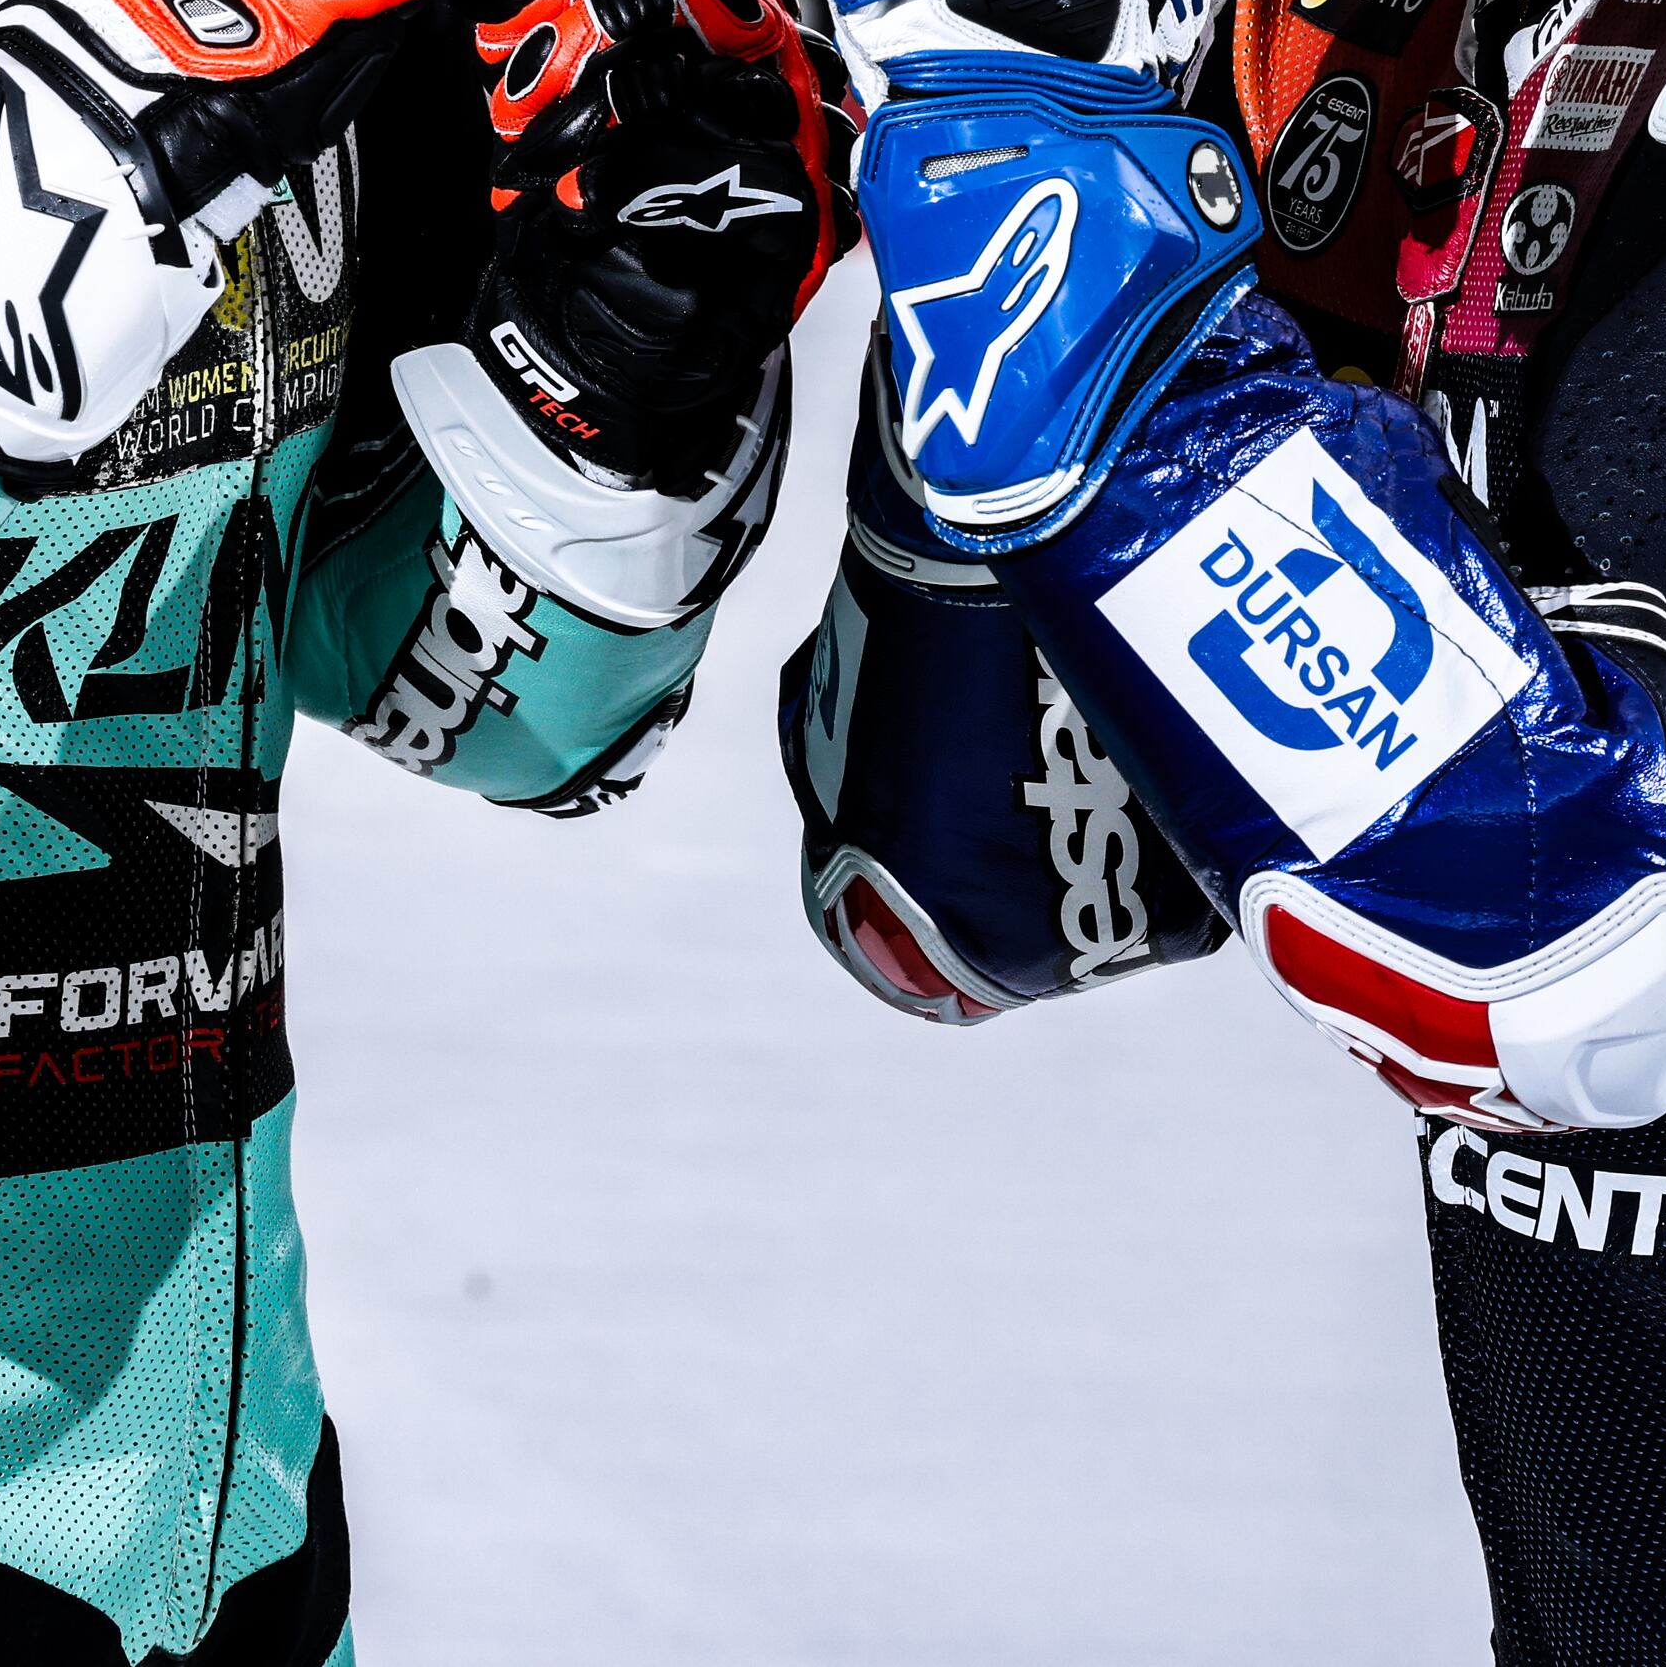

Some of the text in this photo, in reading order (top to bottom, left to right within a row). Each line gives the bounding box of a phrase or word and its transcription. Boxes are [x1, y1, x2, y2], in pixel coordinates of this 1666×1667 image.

[1316, 93, 1367, 119] CESCENT
[1277, 108, 1365, 203] 75
[1288, 197, 1324, 225] YEARS
[1493, 282, 1554, 312] Kabuto
[490, 320, 581, 403] GP
[116, 402, 216, 461] WORLD
[528, 388, 601, 440] TECH
[1200, 525, 1420, 776] DURSAN
